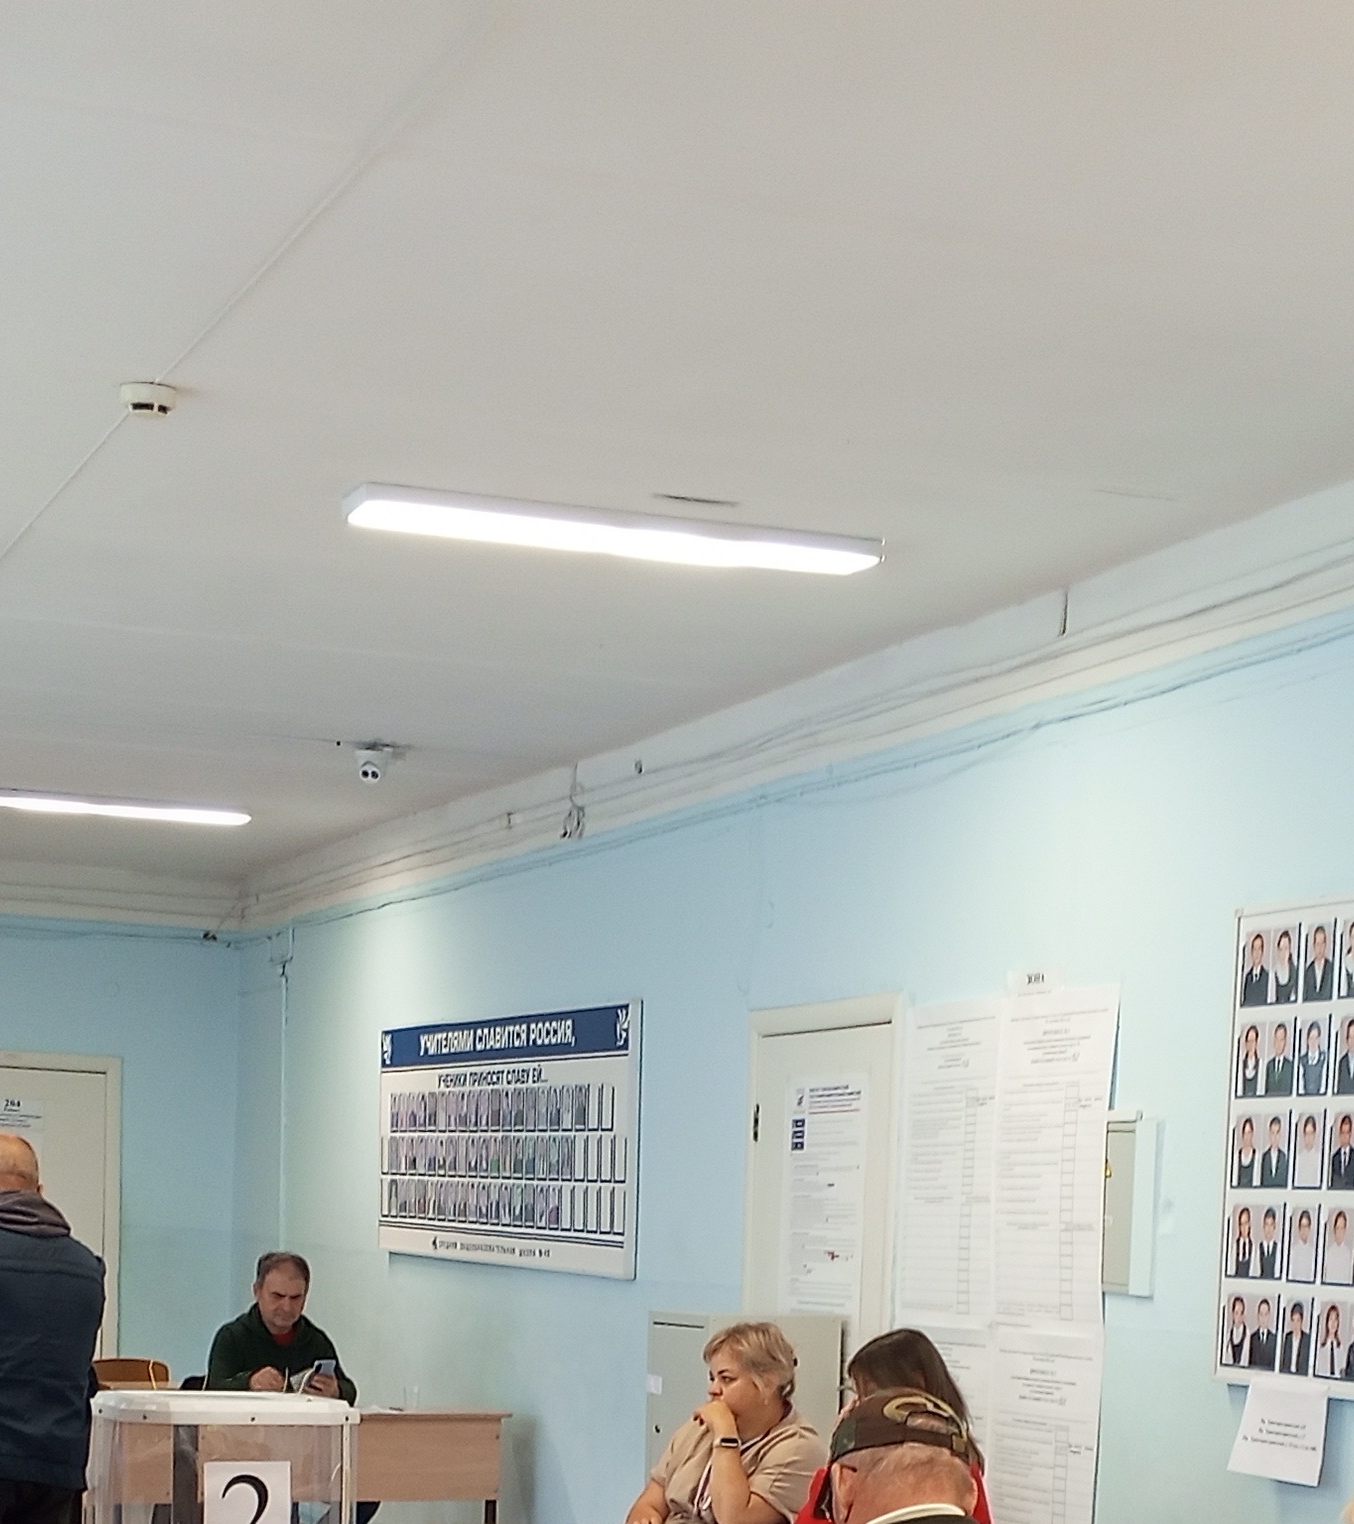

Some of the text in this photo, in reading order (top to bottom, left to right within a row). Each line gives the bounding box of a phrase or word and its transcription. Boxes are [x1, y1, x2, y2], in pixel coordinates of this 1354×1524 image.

[419, 1019, 576, 1057] УЧИТЕЛЯМИ СЛАВИТСЯ РОССИЯ,
